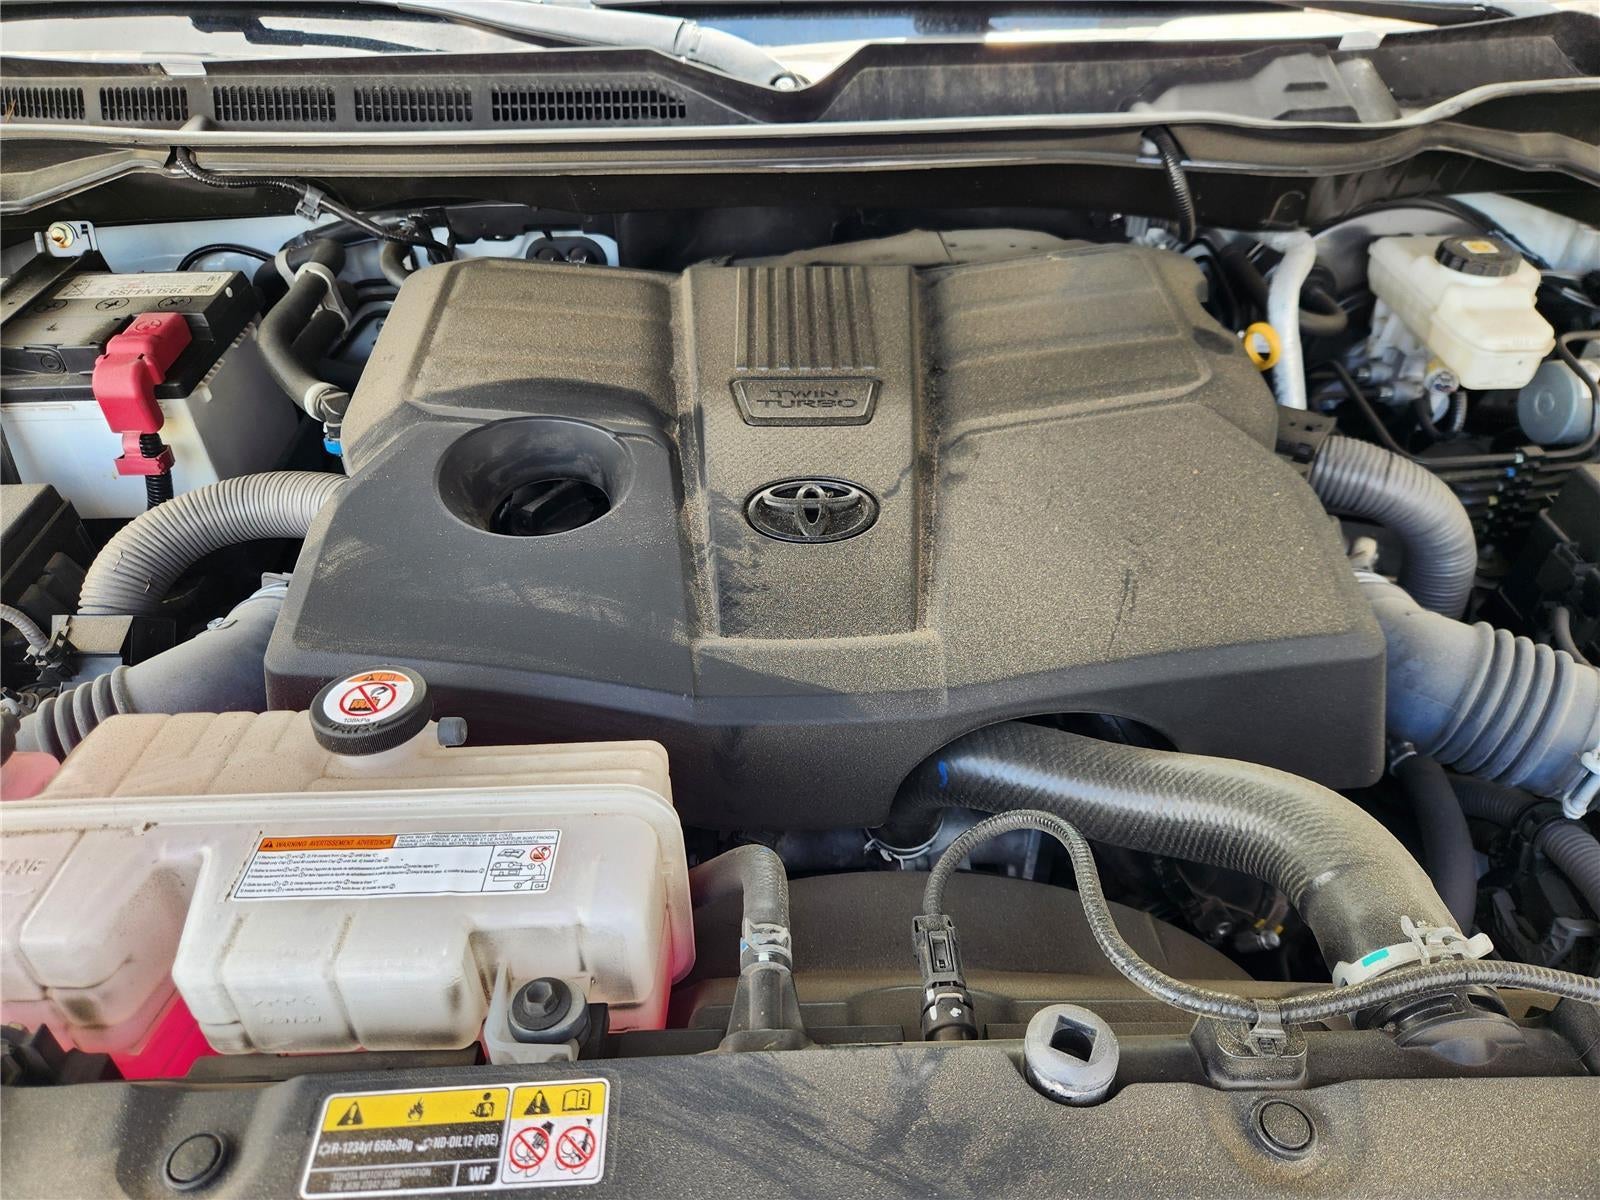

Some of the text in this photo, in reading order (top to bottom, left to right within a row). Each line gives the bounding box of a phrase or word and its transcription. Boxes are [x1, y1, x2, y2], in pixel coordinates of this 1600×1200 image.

[769, 389, 839, 398] TWIN
[756, 398, 858, 409] TURBO
[331, 1140, 374, 1155] R-1234yf
[433, 1134, 474, 1149] ND-OIL12
[474, 1132, 499, 1149] (POE)
[468, 1165, 492, 1182] WF
